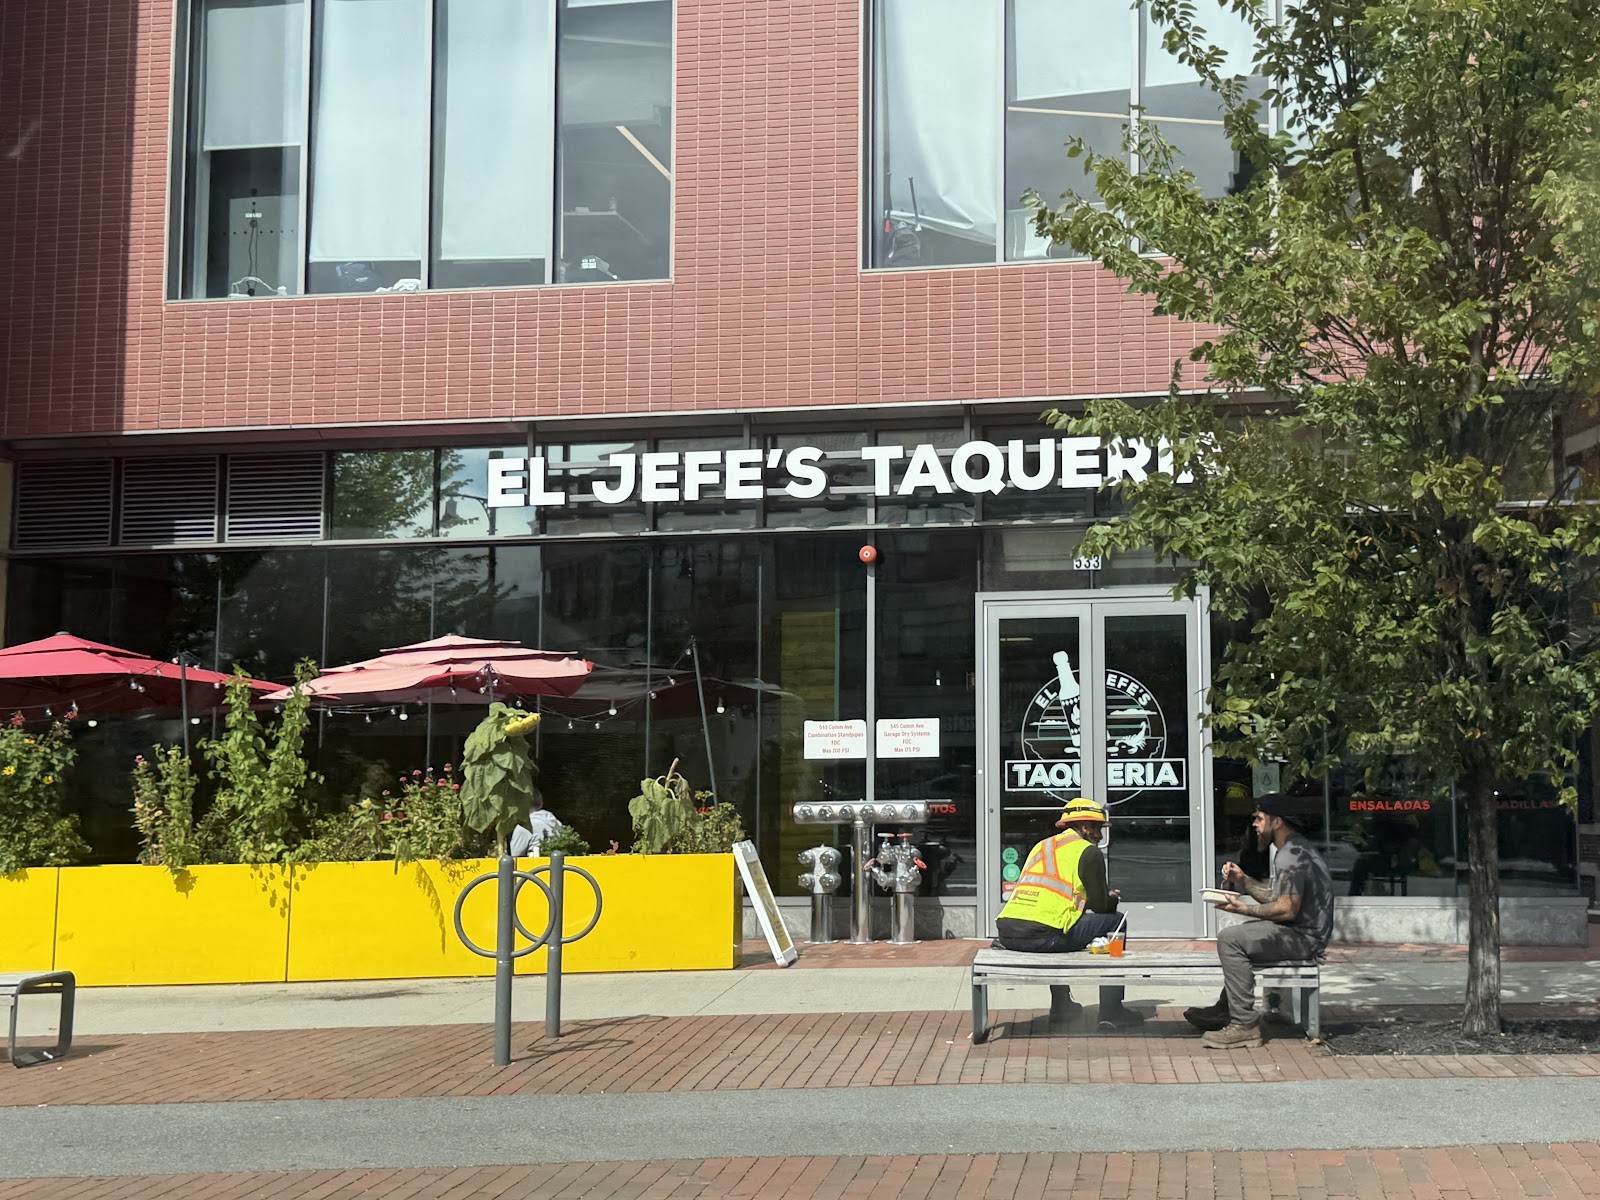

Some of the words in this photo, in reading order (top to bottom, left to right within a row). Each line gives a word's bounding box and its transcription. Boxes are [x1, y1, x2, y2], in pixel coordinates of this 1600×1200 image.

[488, 457, 566, 508] EL
[591, 446, 828, 505] JEFE'S
[1034, 688, 1058, 710] EL
[1105, 673, 1152, 707] EFE'S
[929, 803, 957, 814] ITOS
[1349, 799, 1431, 811] ENSALADAS
